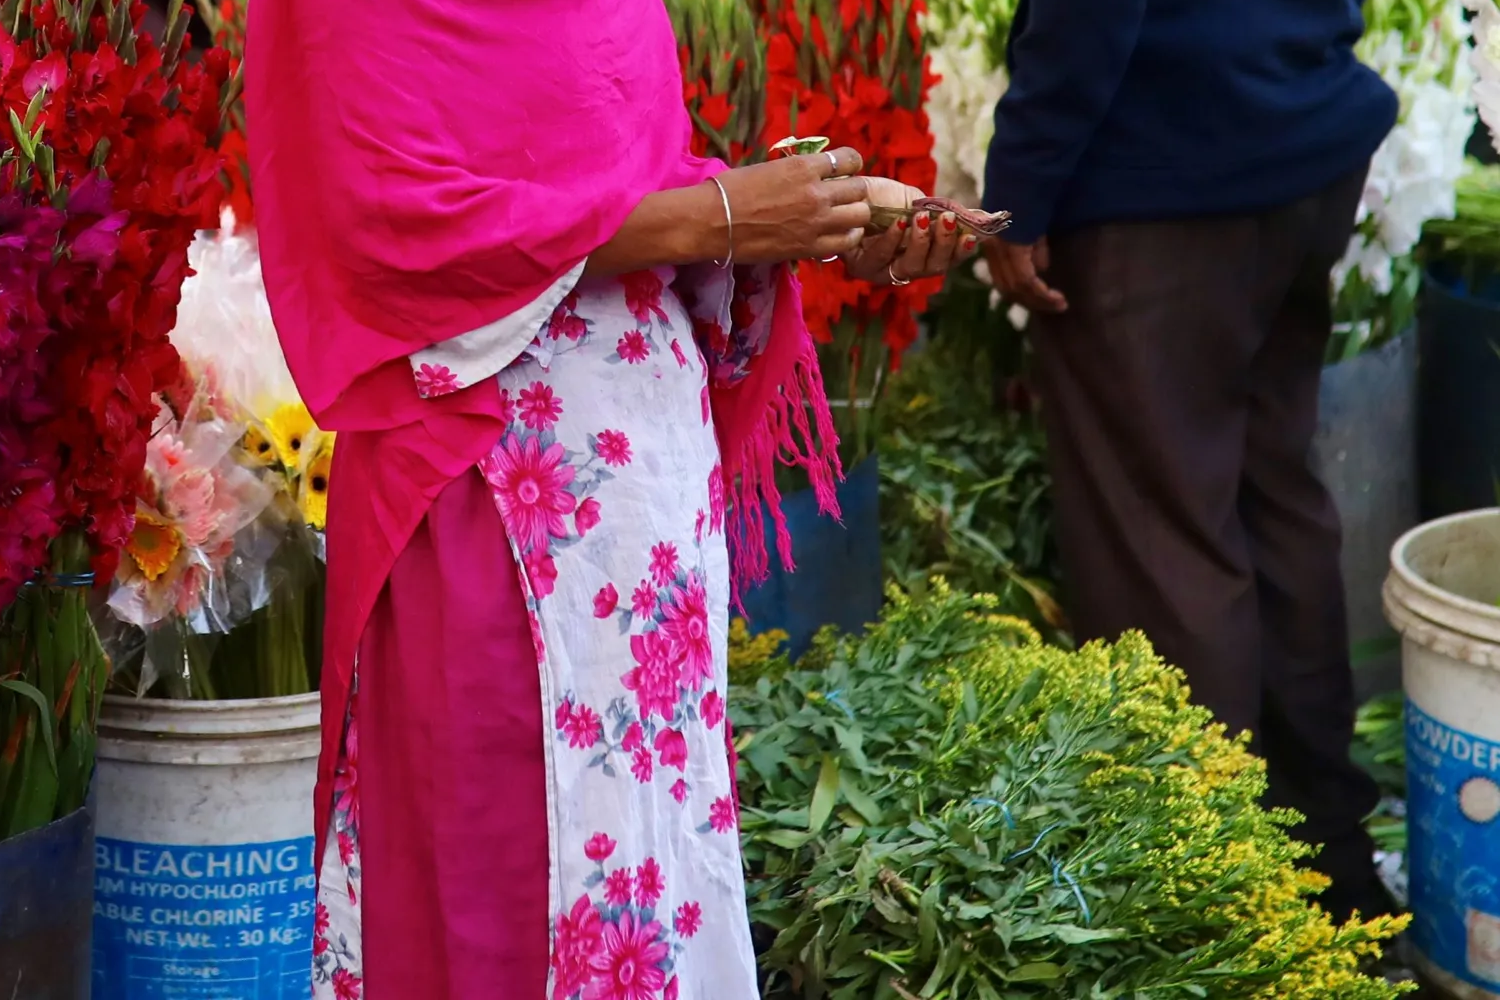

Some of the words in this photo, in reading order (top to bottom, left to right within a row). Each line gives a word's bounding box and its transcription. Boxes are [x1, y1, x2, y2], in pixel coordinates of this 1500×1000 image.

[94, 842, 299, 879] BLEACHING
[130, 878, 288, 900] HYPOCHLORITE
[150, 903, 265, 926] CHLORINE
[125, 928, 169, 946] NET
[237, 930, 264, 947] 30
[162, 963, 220, 979] Storage
